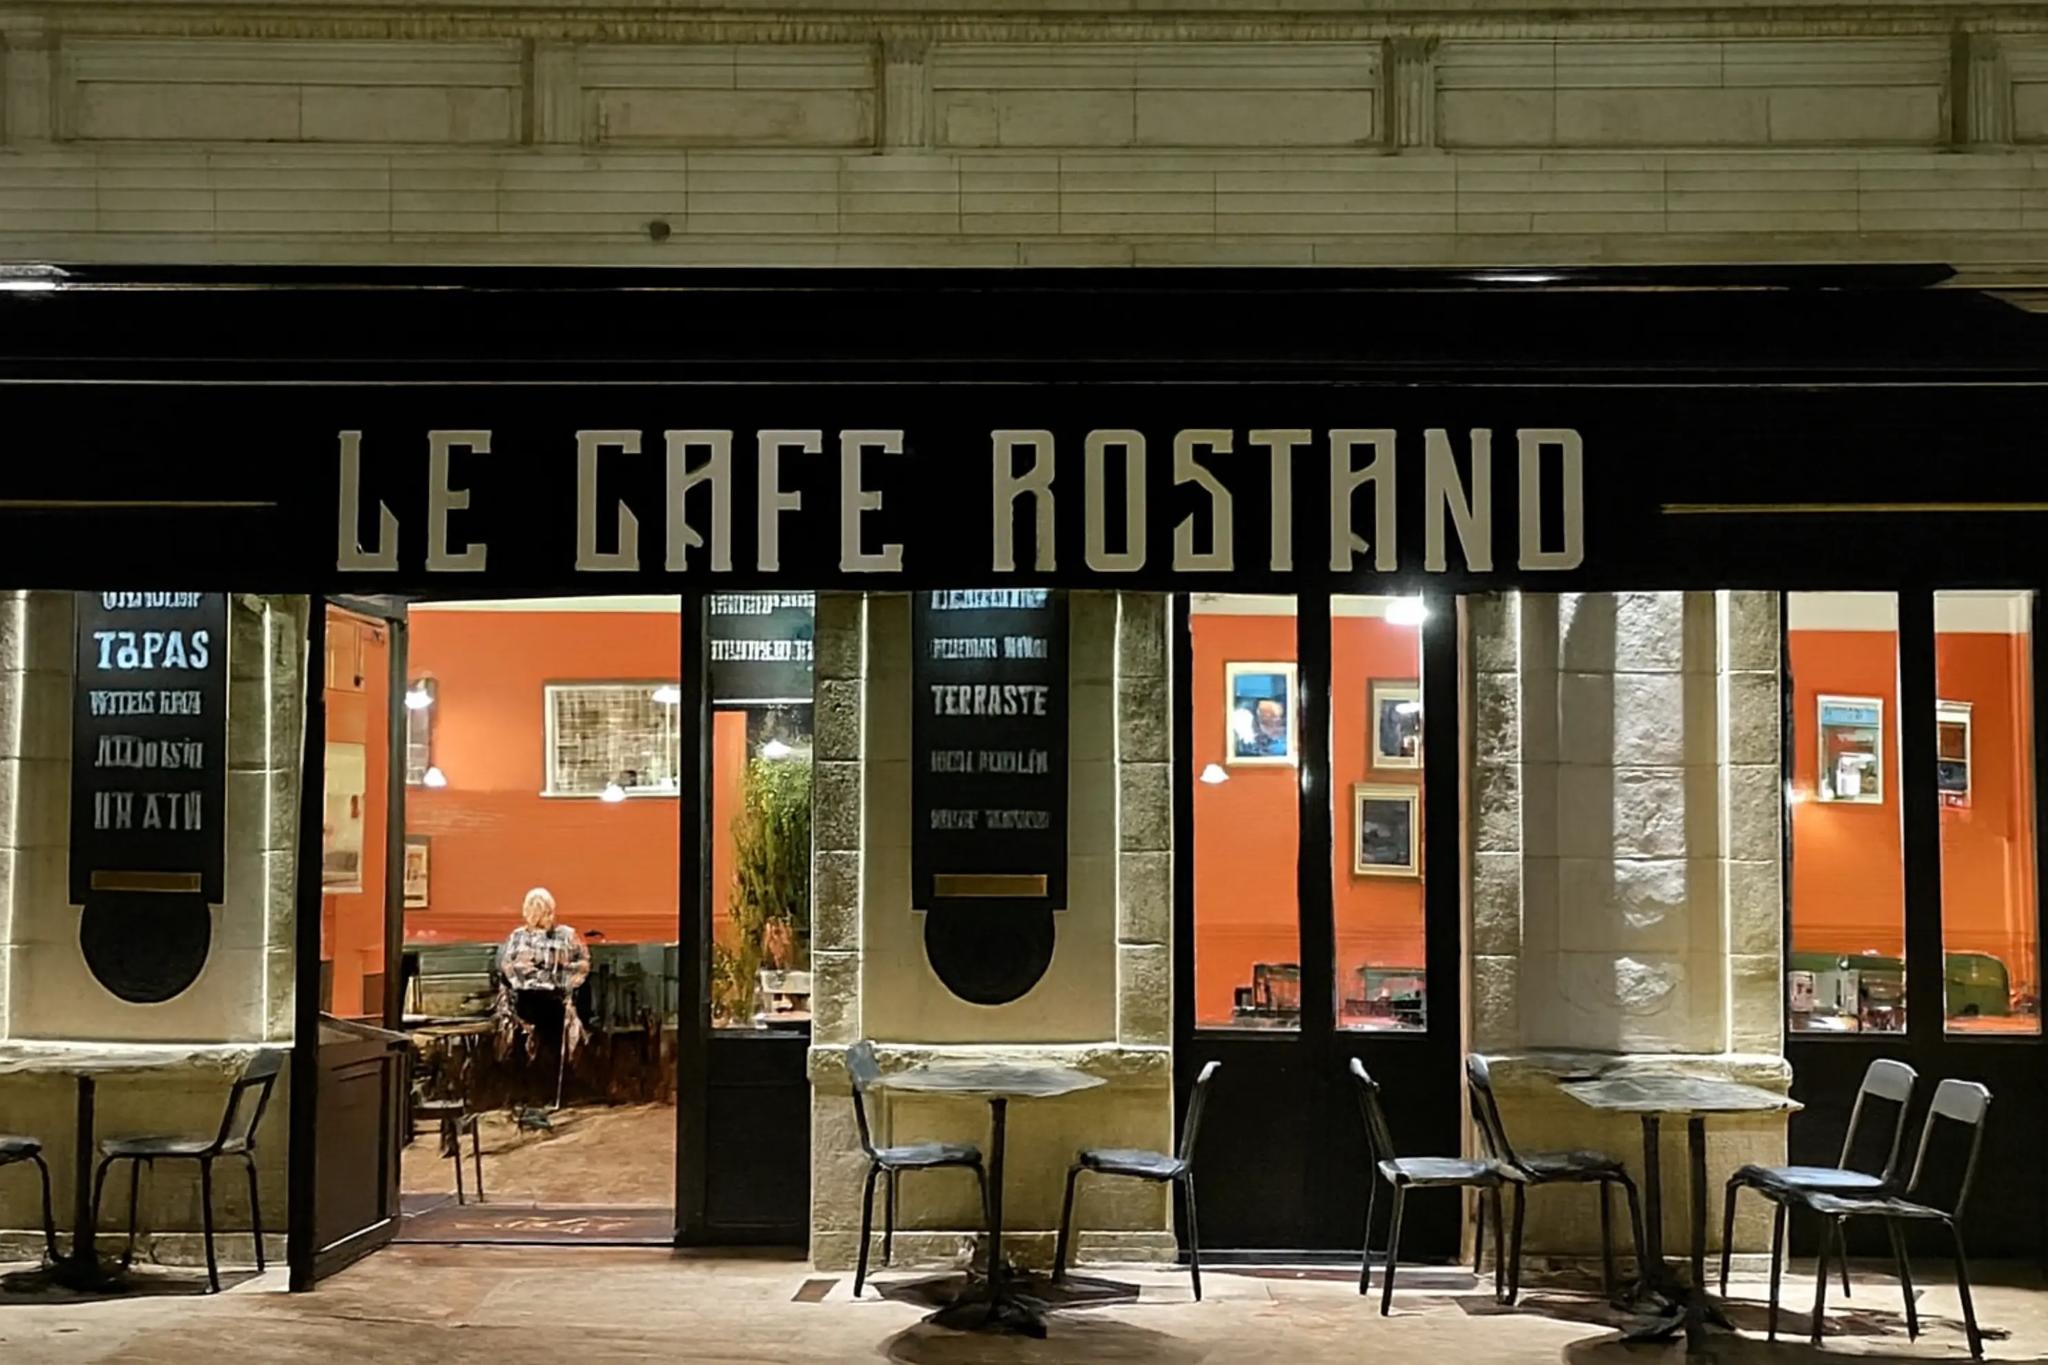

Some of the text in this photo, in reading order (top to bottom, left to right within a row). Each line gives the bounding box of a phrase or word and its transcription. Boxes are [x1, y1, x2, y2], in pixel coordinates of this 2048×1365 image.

[336, 427, 1585, 573] LE CAFE ROSTAND
